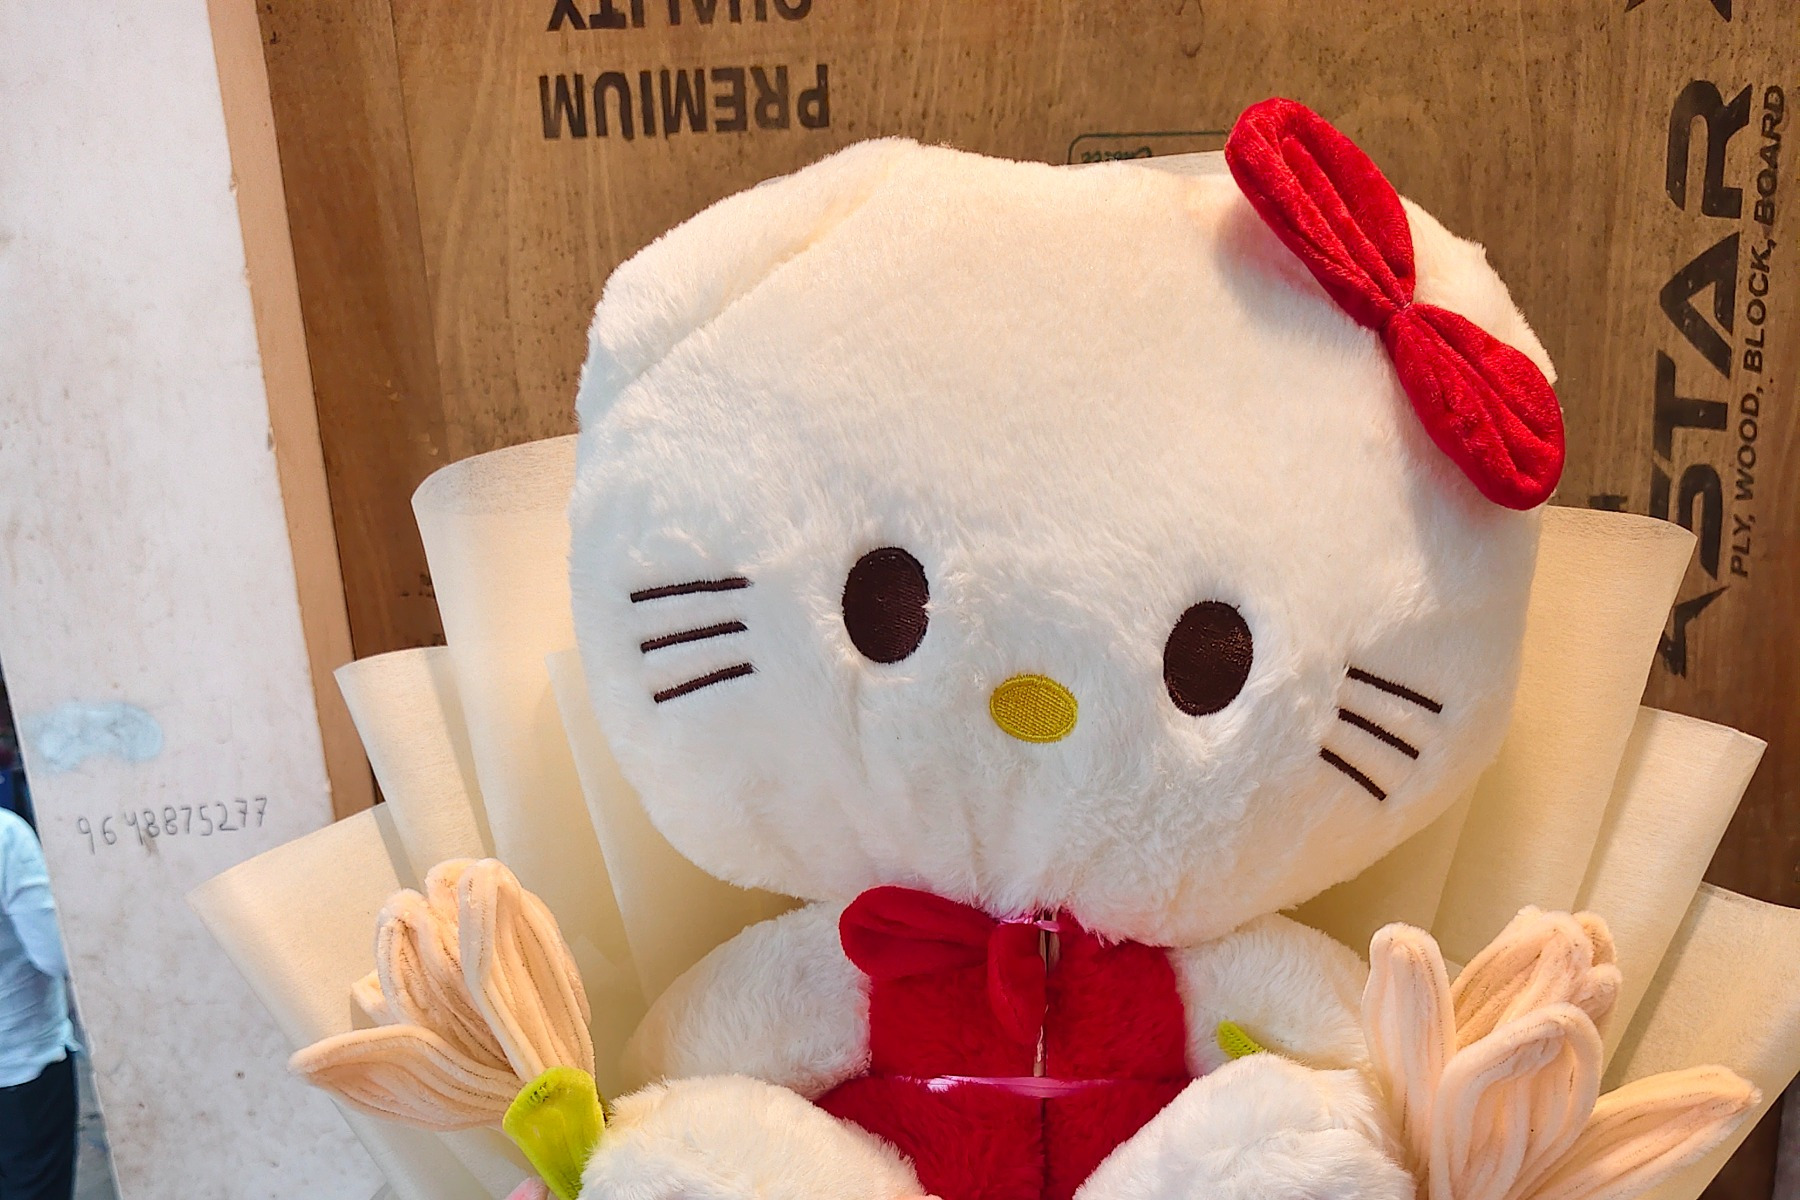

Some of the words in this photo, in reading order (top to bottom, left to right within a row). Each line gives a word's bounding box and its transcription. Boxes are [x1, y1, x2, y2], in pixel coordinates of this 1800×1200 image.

[539, 63, 831, 140] PREMIUM
[1755, 84, 1785, 226] BOARD
[1650, 79, 1753, 580] STAR
[1744, 238, 1777, 374] BLOCK,
[1735, 385, 1763, 503] WOOD,
[1730, 513, 1757, 578] PLY,
